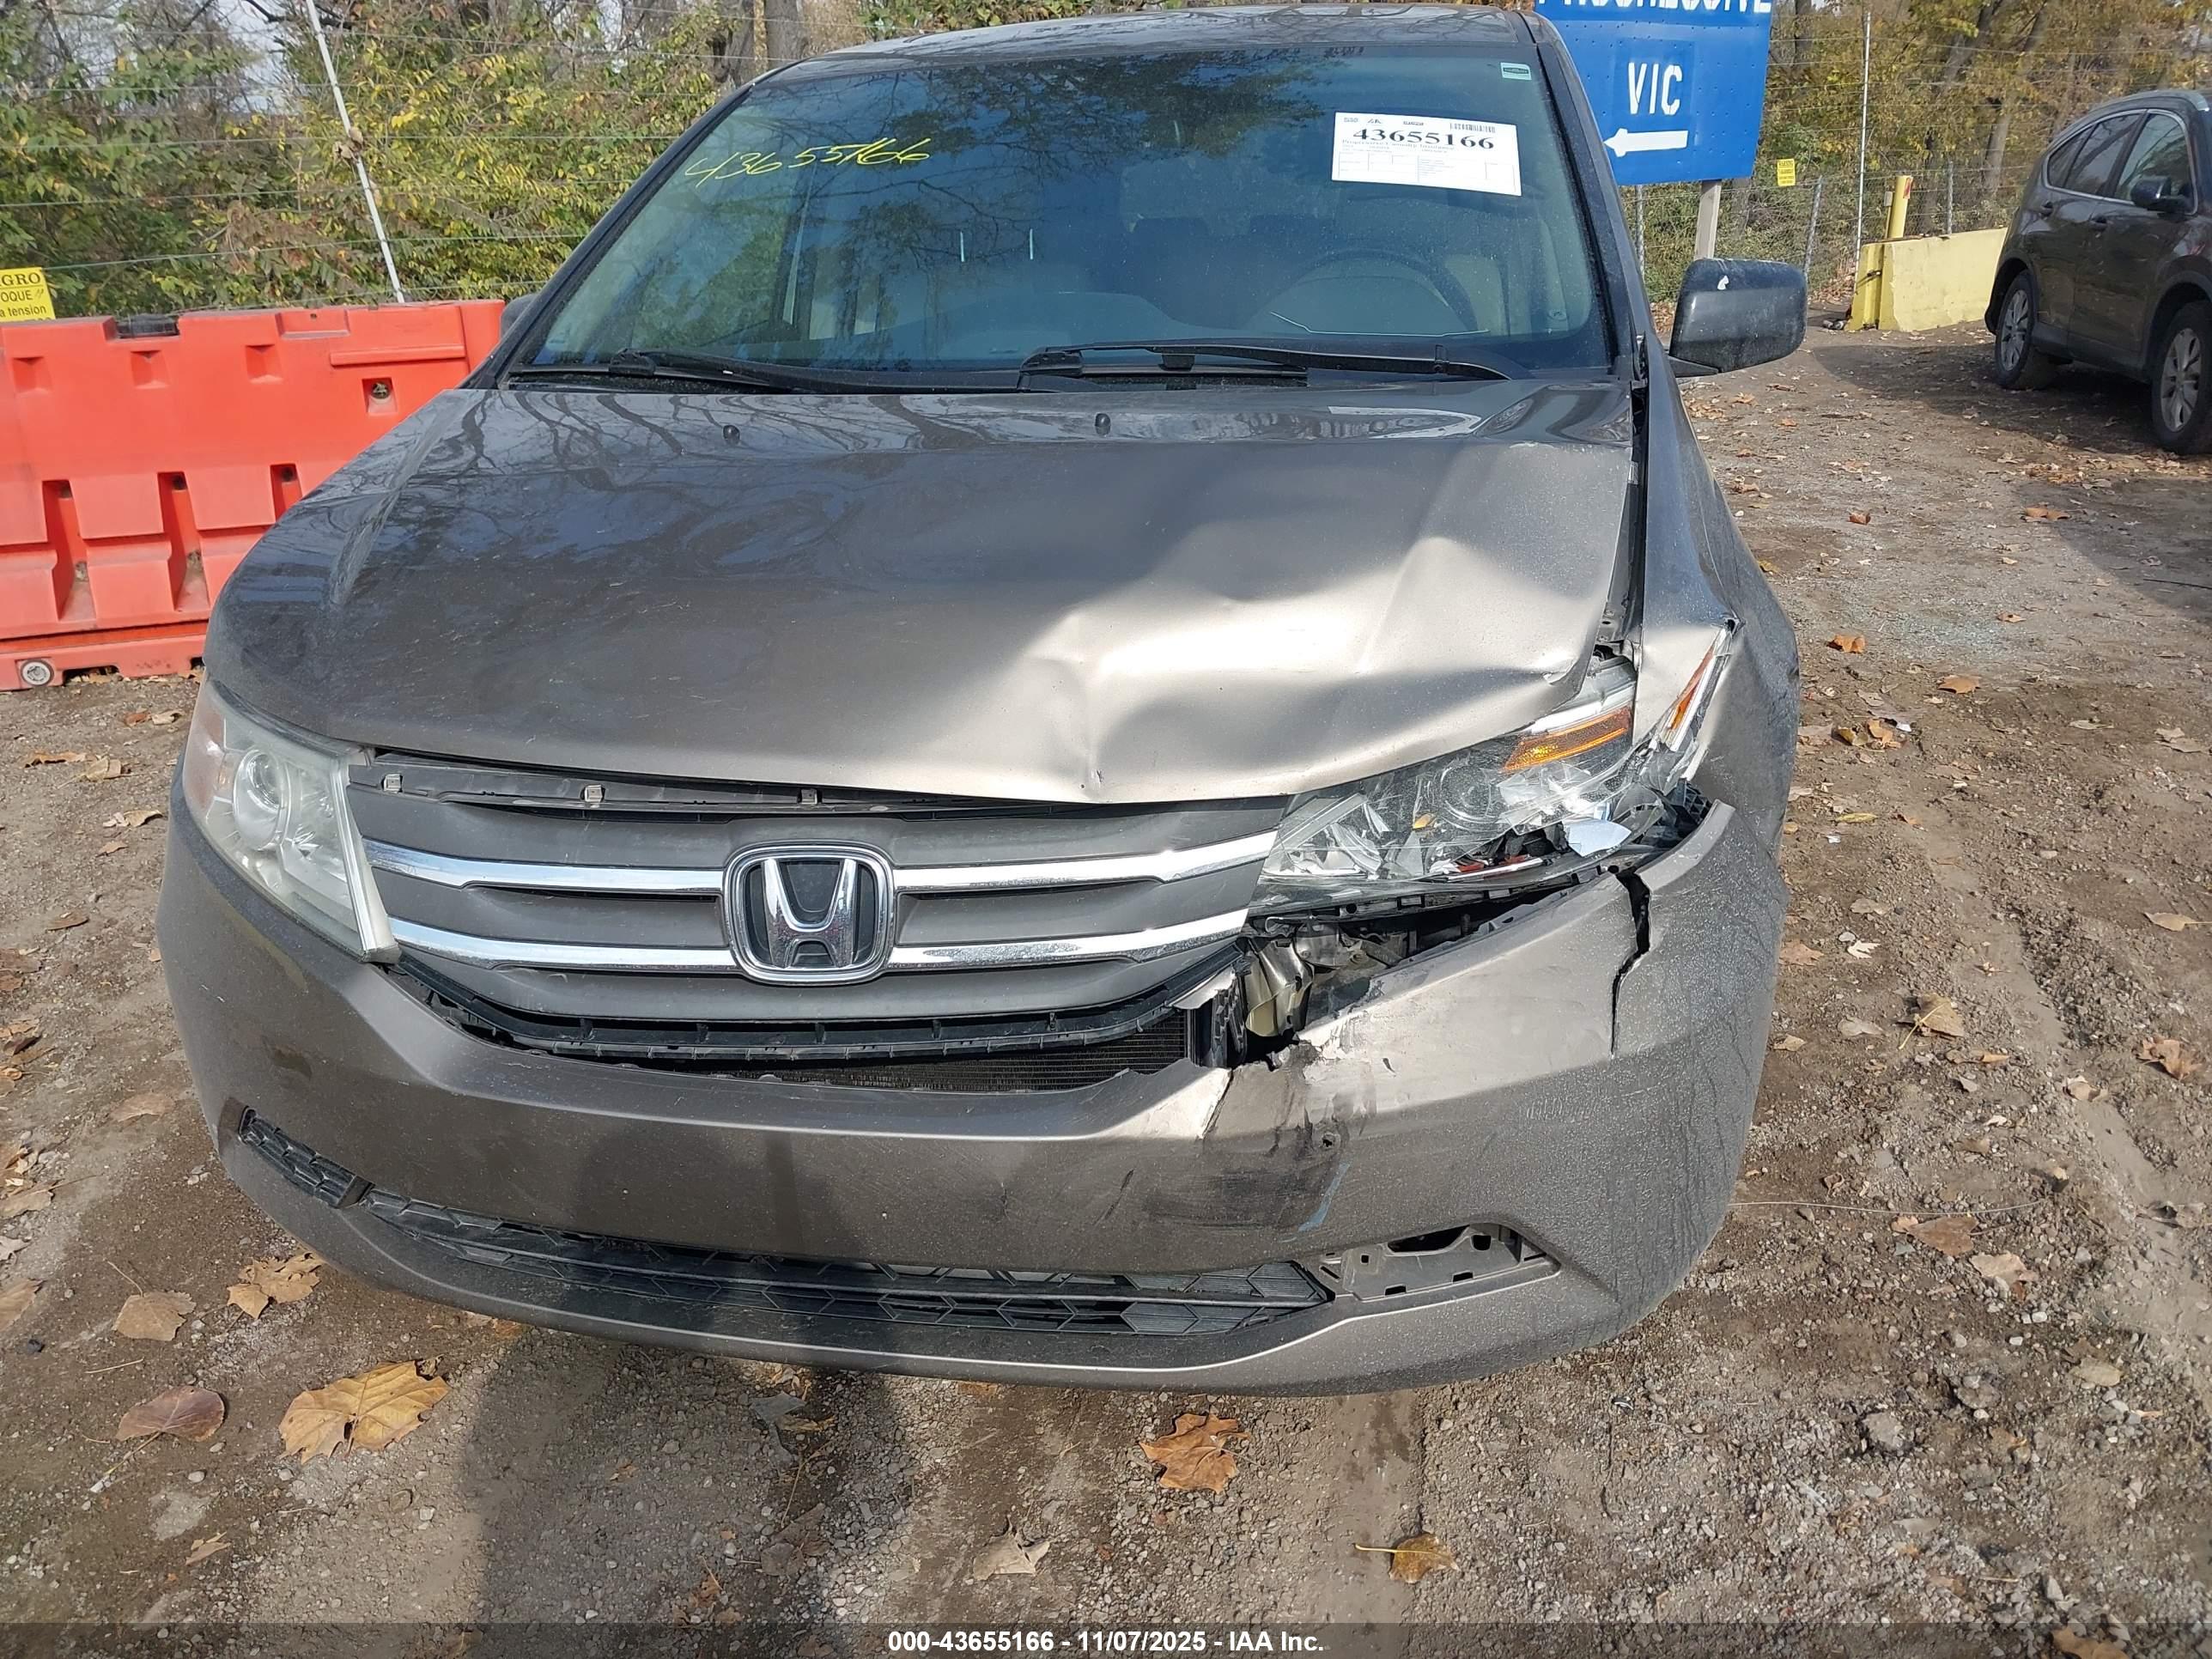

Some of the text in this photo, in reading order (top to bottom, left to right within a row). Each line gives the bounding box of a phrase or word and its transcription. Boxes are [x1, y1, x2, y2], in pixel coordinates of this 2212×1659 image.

[1628, 62, 1682, 115] VIC
[1352, 127, 1494, 149] 43655166
[0, 272, 40, 286] GRO
[8, 304, 46, 317] tension
